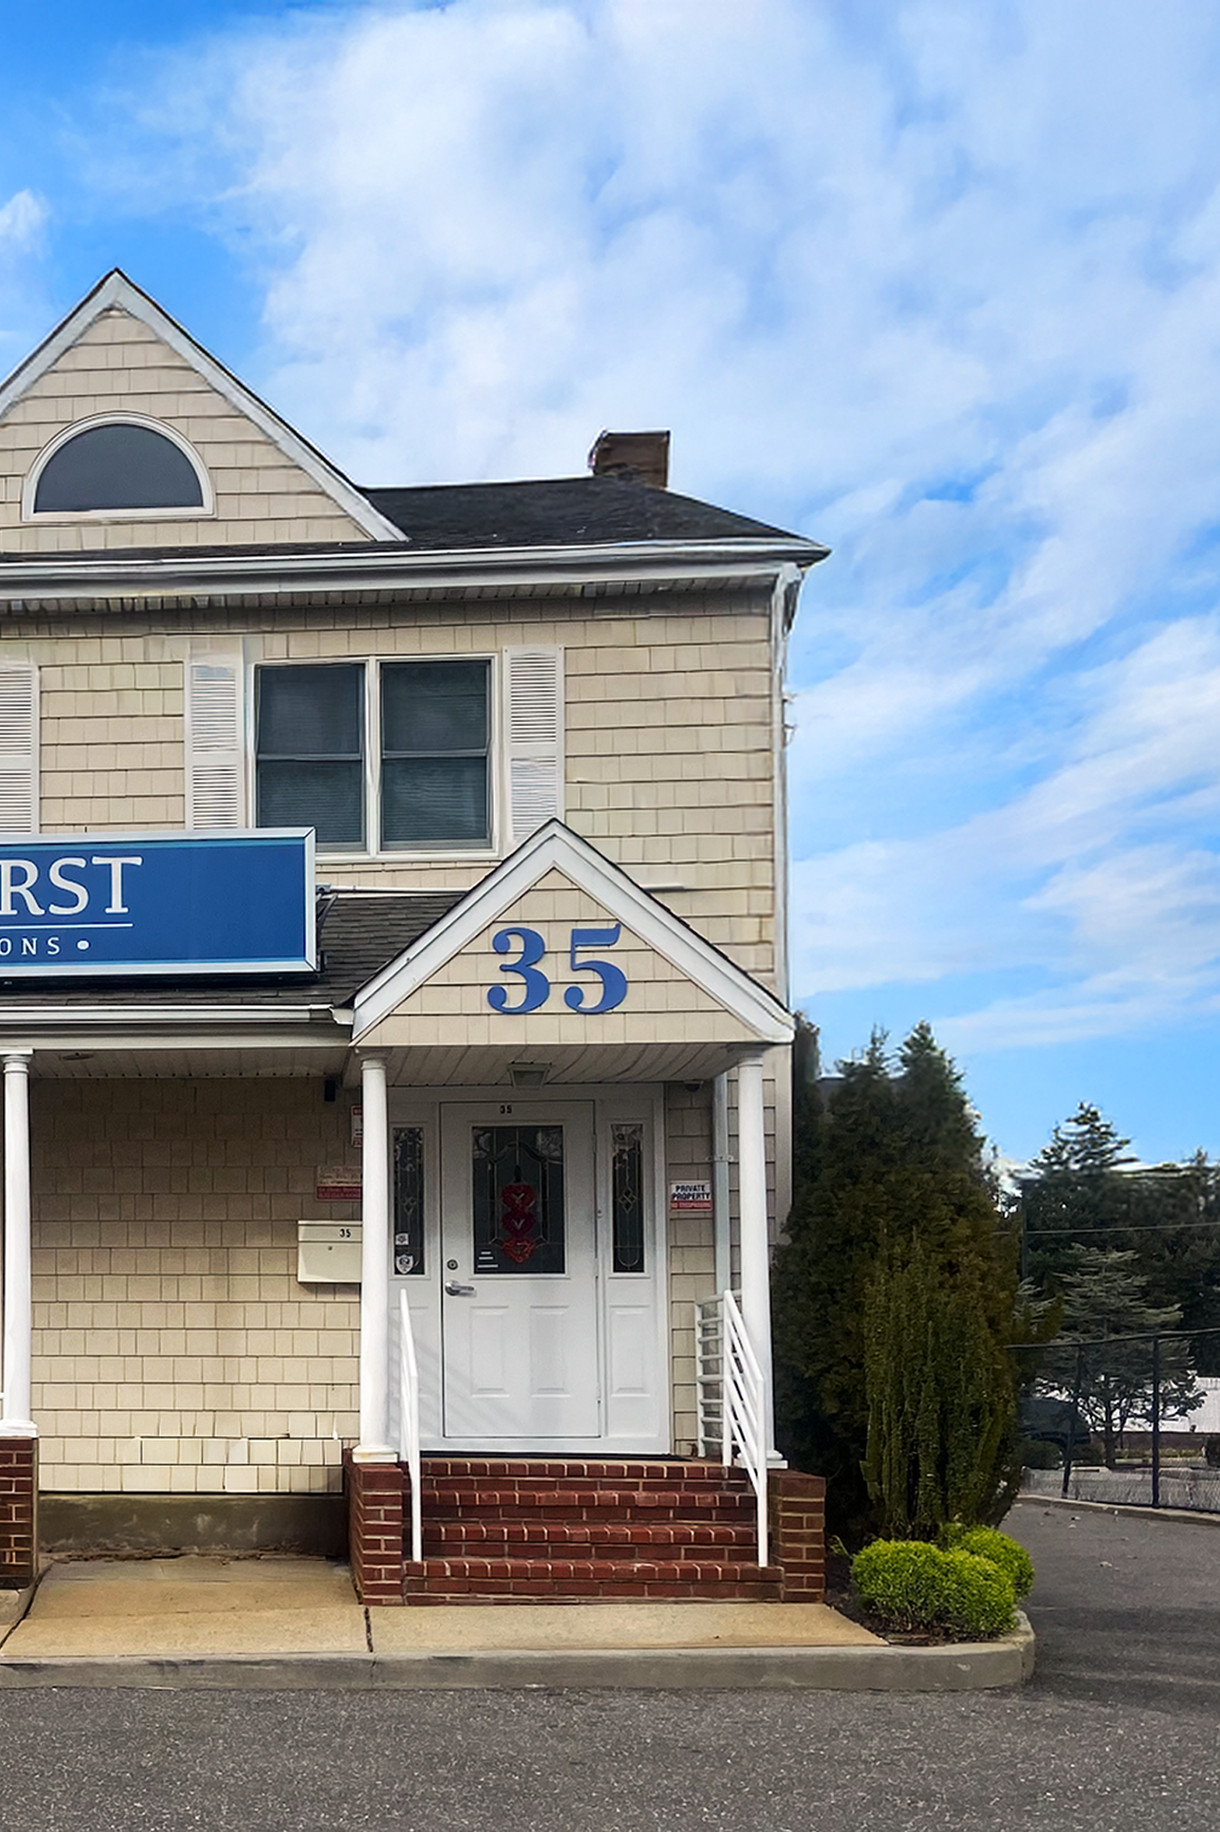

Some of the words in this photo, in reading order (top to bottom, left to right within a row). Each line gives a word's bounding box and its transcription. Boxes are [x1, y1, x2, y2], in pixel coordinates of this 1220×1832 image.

[486, 922, 629, 1015] 35
[499, 1104, 513, 1115] 35
[675, 1184, 706, 1192] PRIVATE
[671, 1192, 711, 1200] PROPERTY
[339, 1228, 352, 1239] 35
